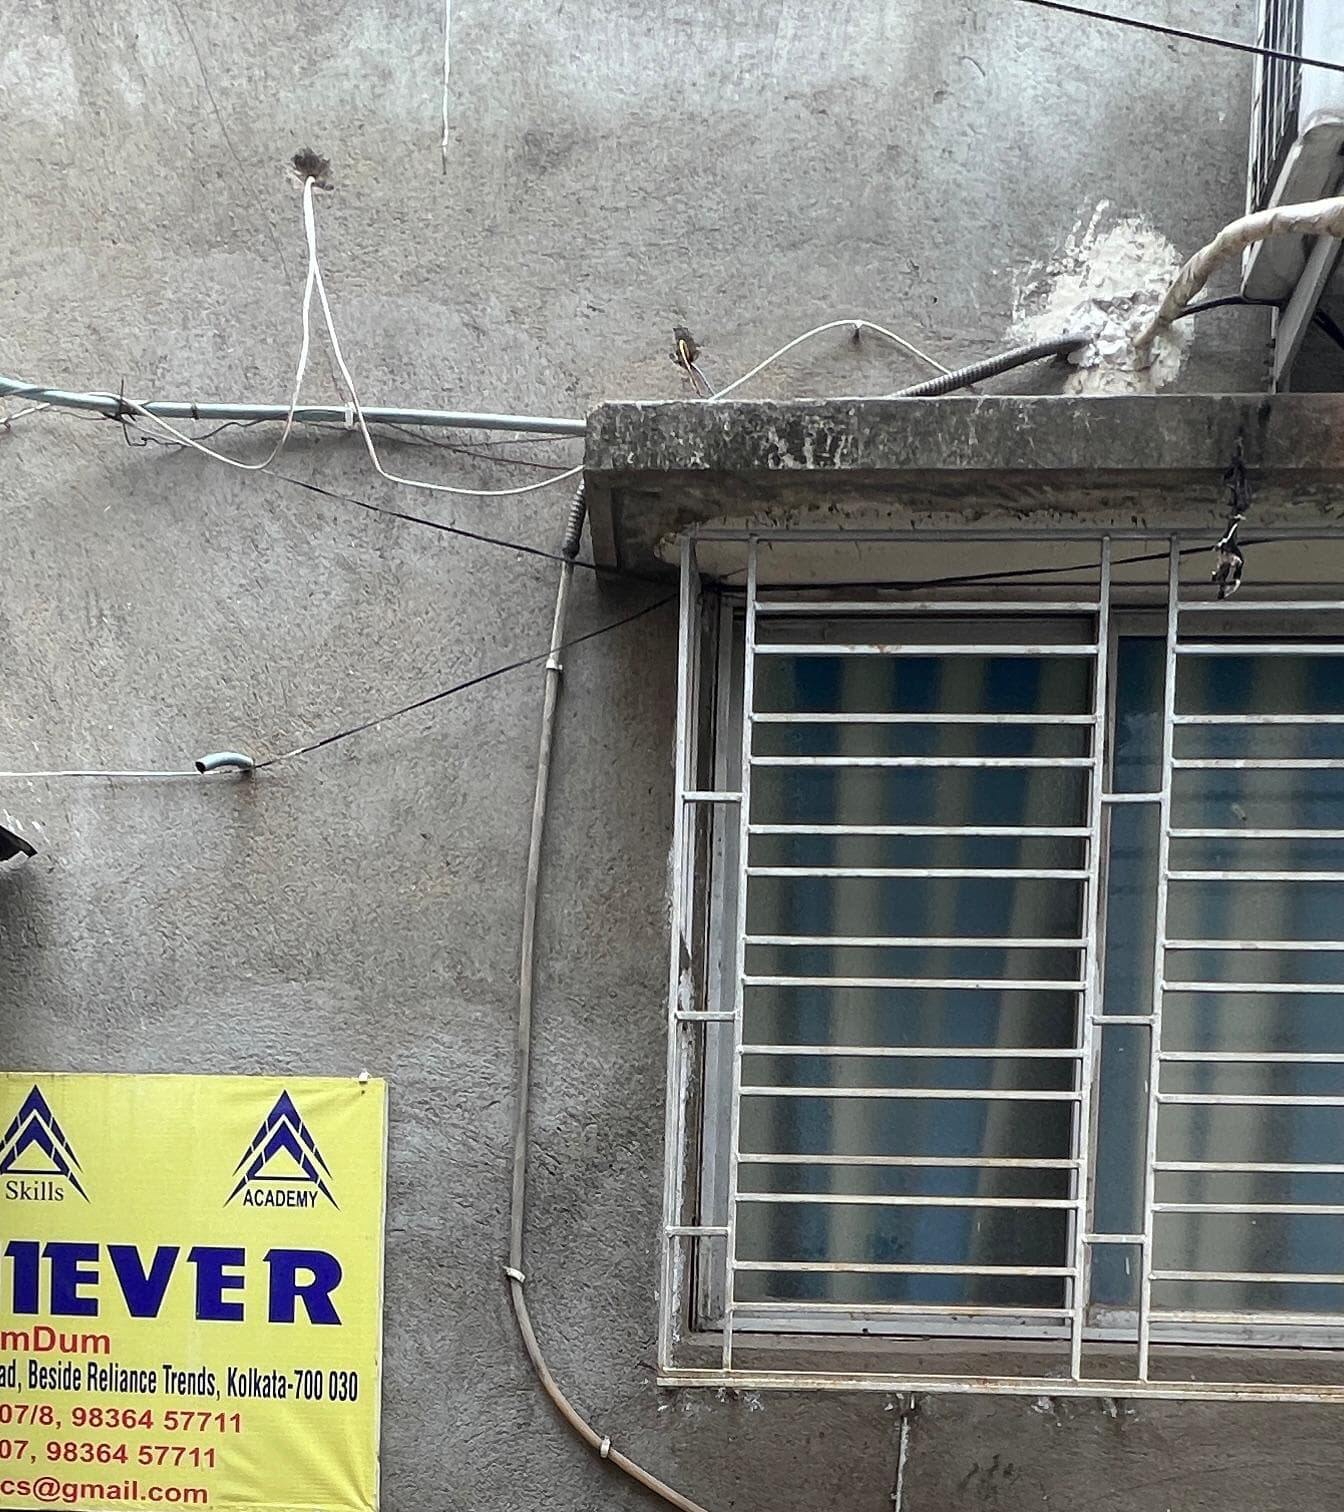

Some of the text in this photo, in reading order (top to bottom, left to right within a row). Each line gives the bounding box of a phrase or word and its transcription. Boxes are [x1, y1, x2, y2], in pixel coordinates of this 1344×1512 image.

[5, 1180, 64, 1202] Skills
[242, 1189, 318, 1208] ACADEMY
[28, 1360, 81, 1391] Beside
[87, 1362, 157, 1394] Reliance
[162, 1365, 221, 1400] Trends,
[227, 1367, 323, 1400] Kolkata-700
[328, 1371, 358, 1402] 030
[71, 1408, 154, 1430] 98364
[163, 1412, 242, 1433] 57711
[46, 1442, 128, 1464] 98364
[137, 1446, 216, 1468] 57711
